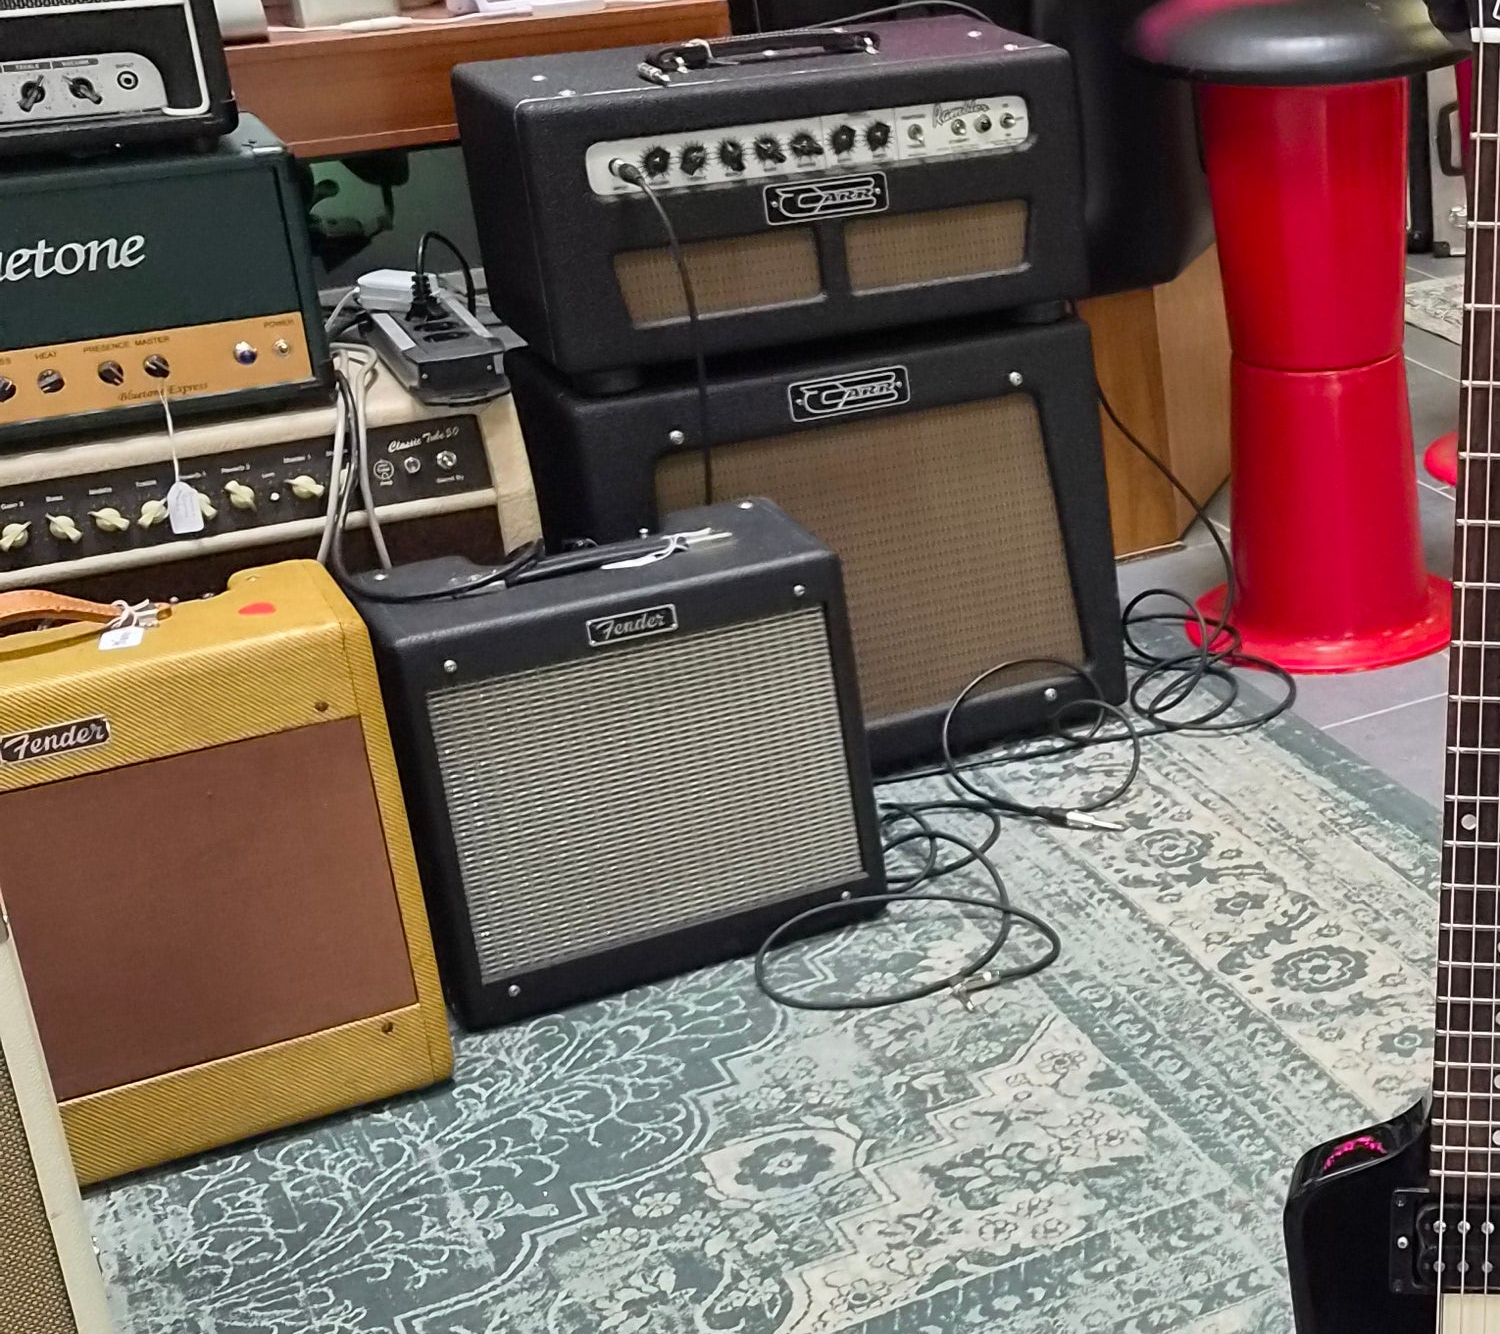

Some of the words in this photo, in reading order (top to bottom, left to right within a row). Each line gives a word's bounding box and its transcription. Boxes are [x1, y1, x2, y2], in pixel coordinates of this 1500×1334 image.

[263, 318, 294, 329] POWER
[83, 341, 130, 353] PRESENCE
[135, 335, 170, 347] MASTER
[34, 351, 58, 361] HEAT
[387, 437, 422, 453] Classic
[595, 613, 665, 640] Fender
[3, 723, 105, 761] Fender
